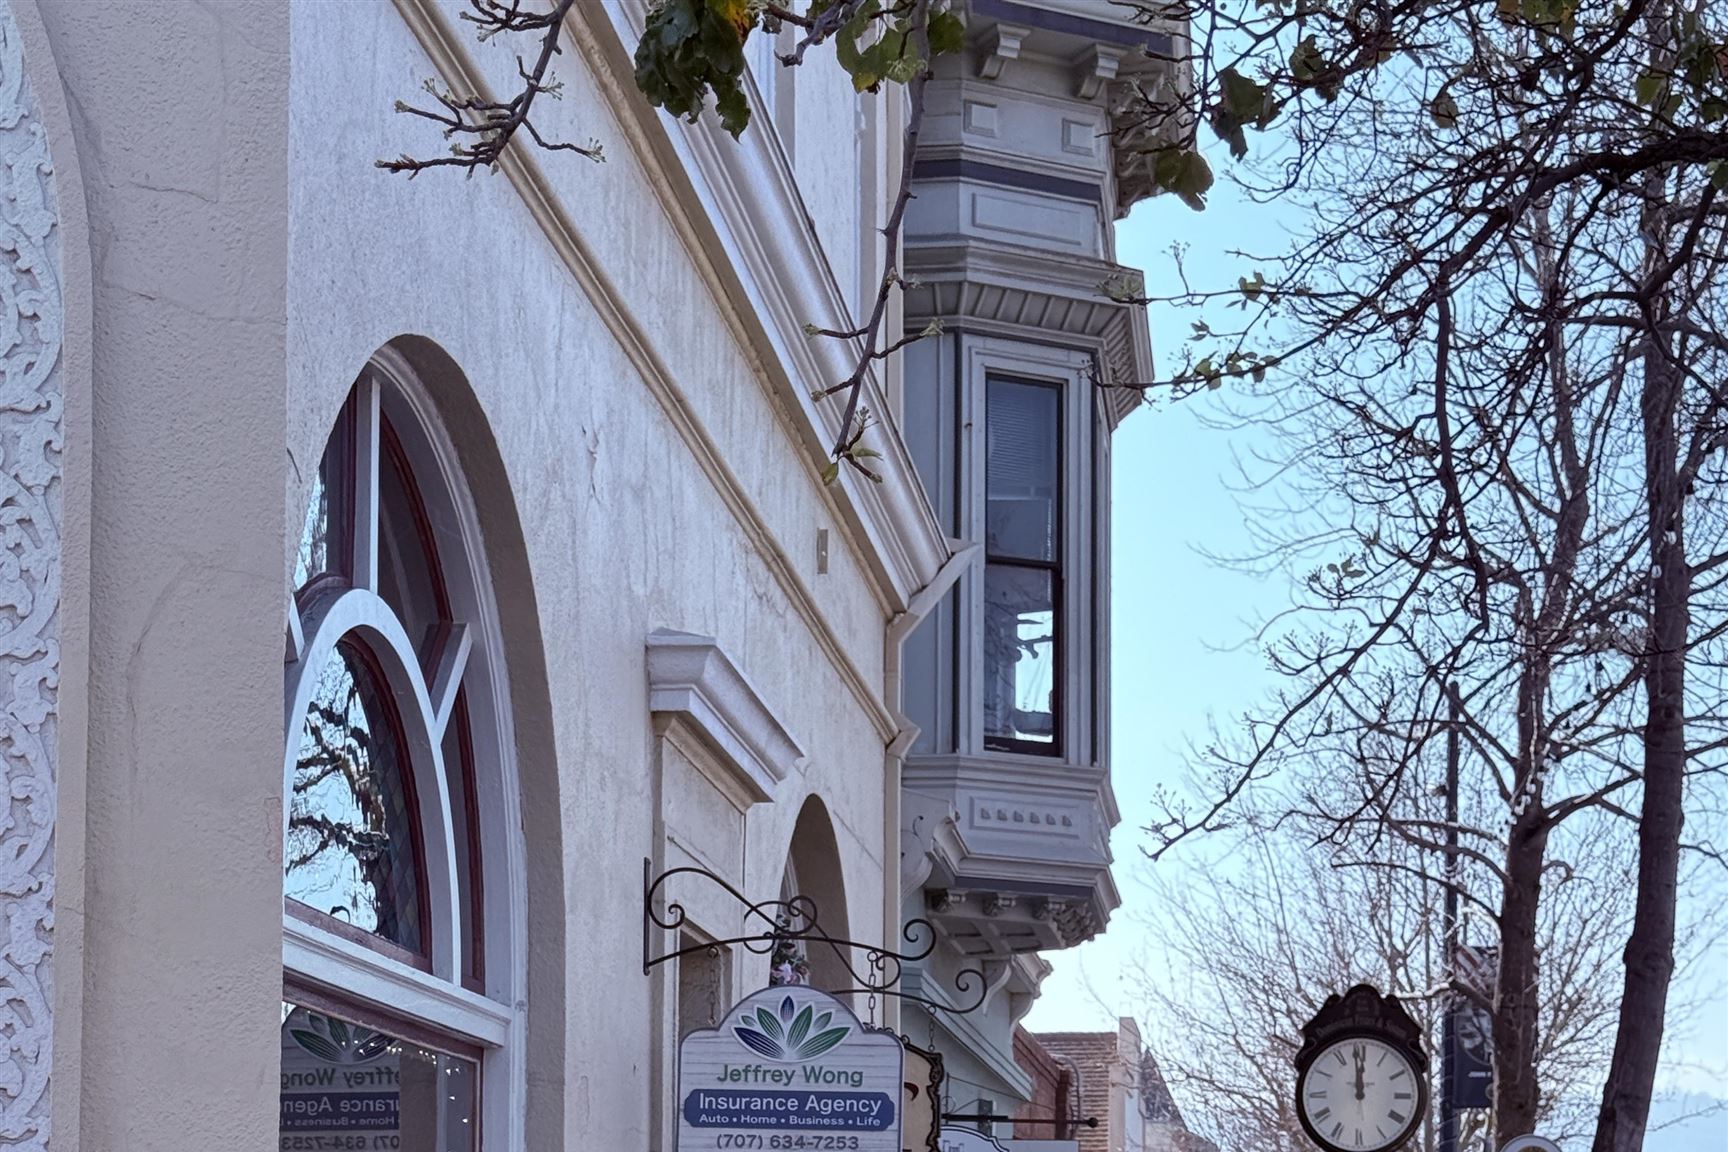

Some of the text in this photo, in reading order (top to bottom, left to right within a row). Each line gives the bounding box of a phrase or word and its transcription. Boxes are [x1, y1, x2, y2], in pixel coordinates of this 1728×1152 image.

[717, 1064, 864, 1087] Jeffrey Wong
[699, 1092, 882, 1115] Insurance Agency
[699, 1115, 881, 1126] Auto Home Business Life
[716, 1134, 860, 1150] (707) 634-7253
